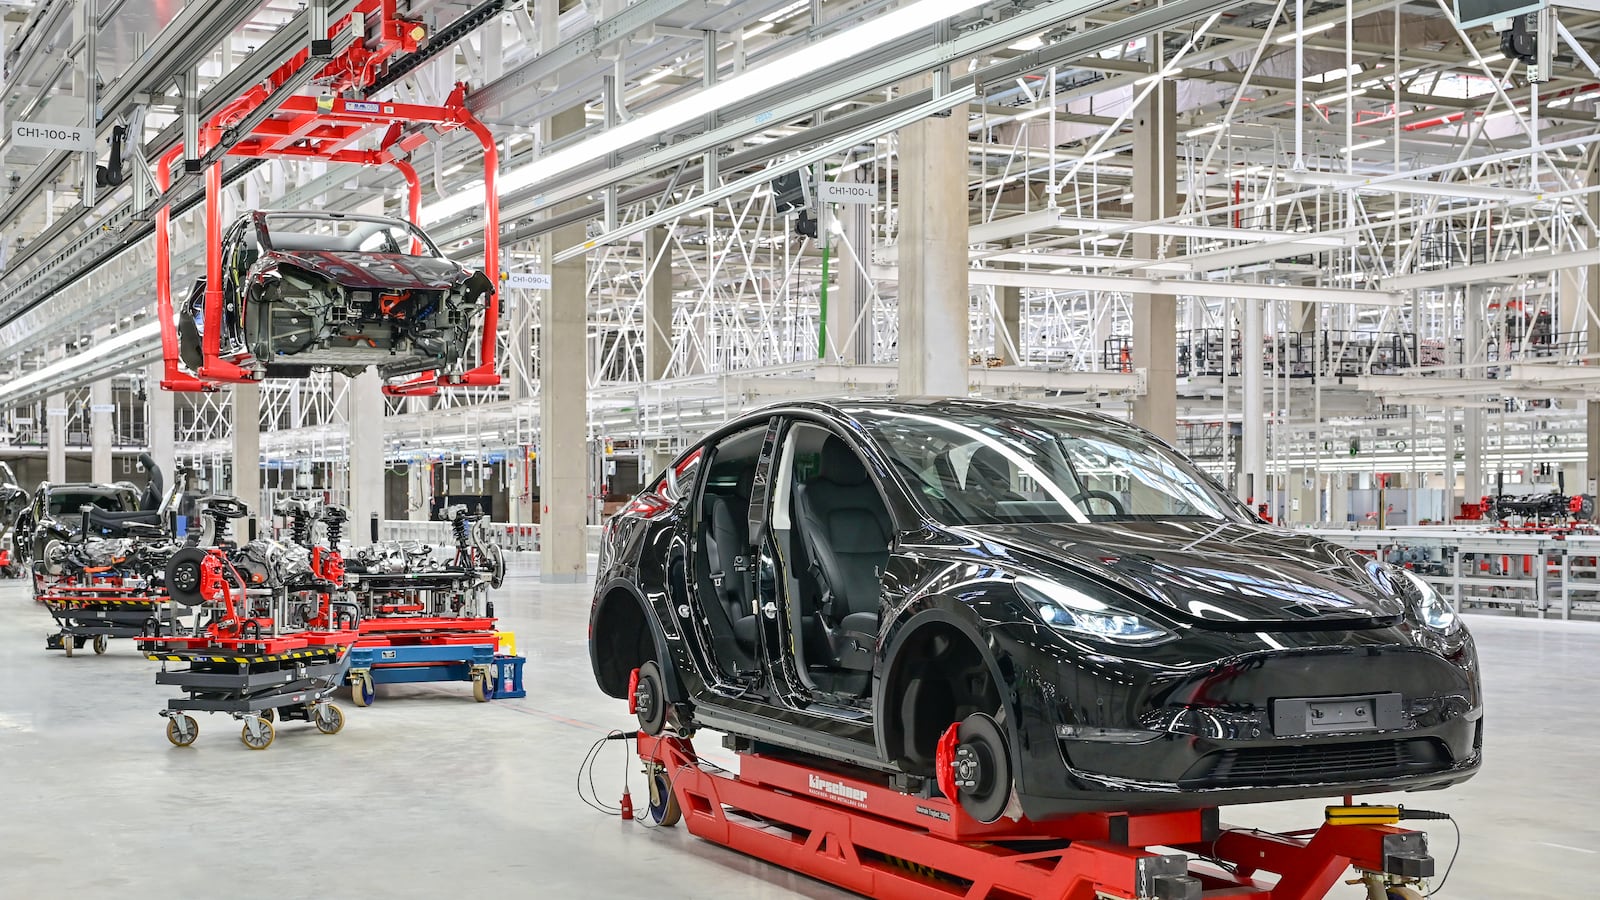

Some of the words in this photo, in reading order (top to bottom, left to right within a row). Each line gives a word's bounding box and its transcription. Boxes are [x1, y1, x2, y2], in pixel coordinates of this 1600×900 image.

[17, 127, 81, 142] CH1-100-R
[829, 186, 874, 197] CH1-100-L
[512, 276, 549, 284] CH1-090-L
[808, 774, 868, 802] kirschner
